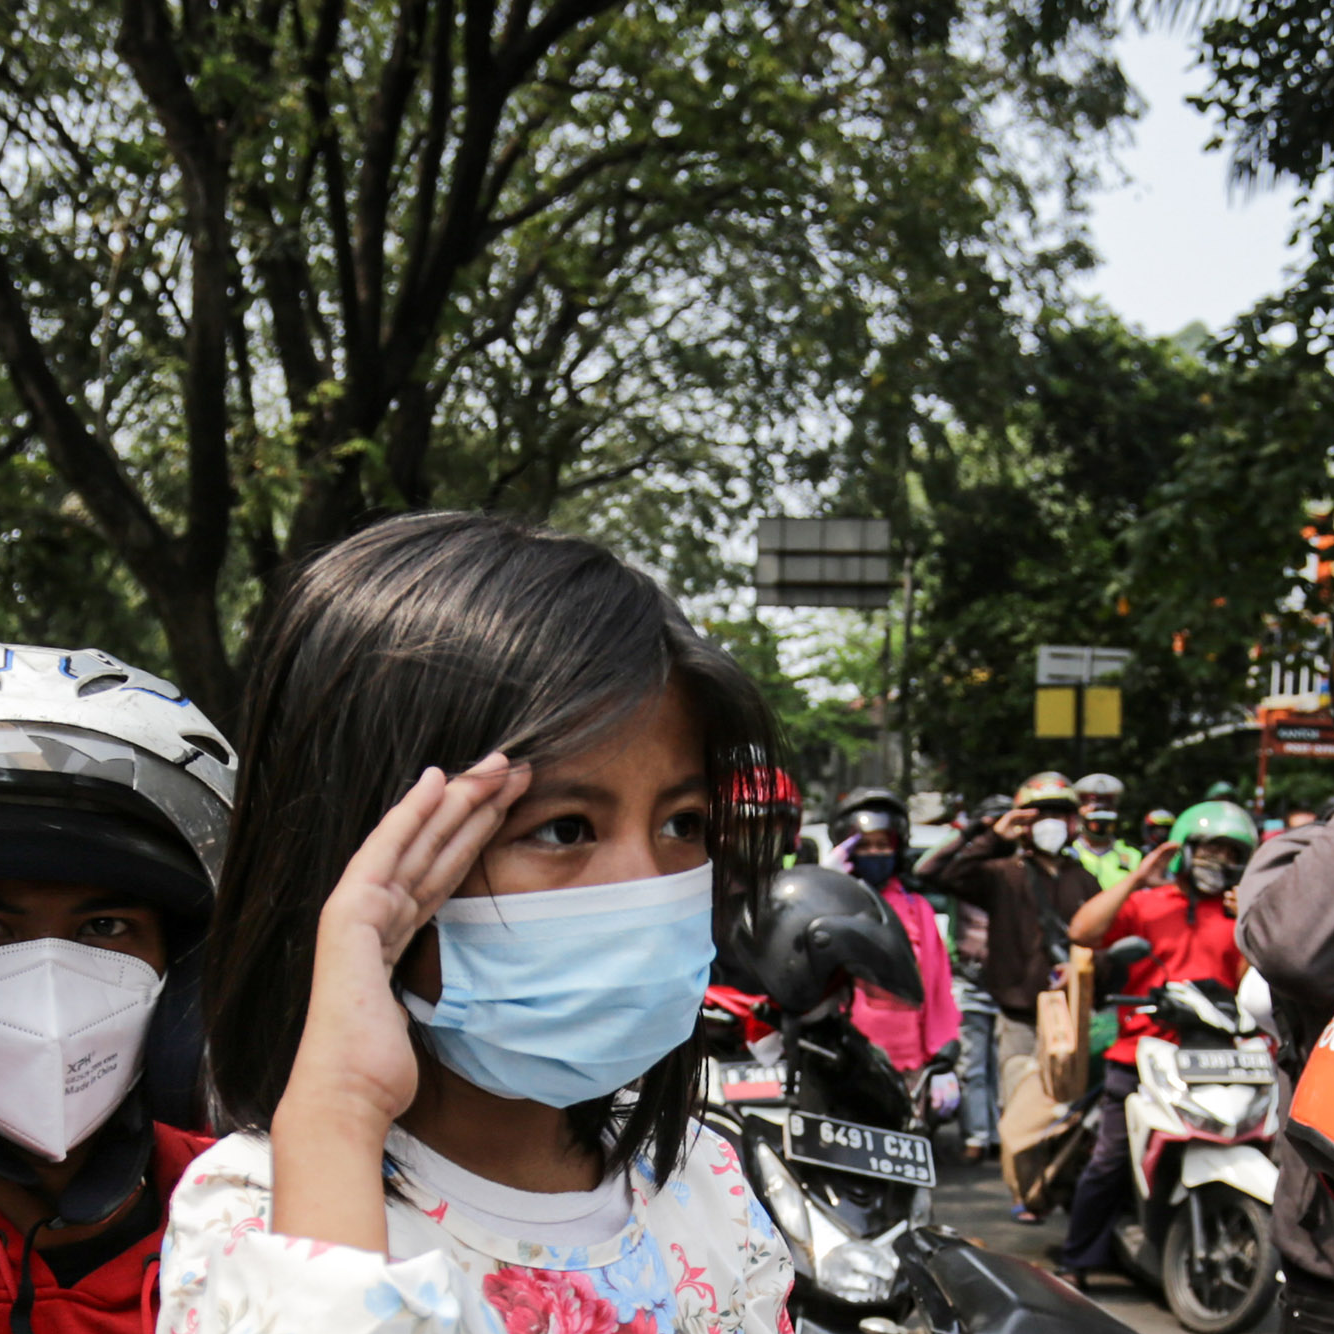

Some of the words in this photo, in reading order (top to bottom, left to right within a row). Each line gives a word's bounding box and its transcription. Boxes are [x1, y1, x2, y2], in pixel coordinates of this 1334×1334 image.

[65, 1081, 90, 1097] Made
[97, 1062, 118, 1079] China
[819, 1121, 875, 1152] 6491
